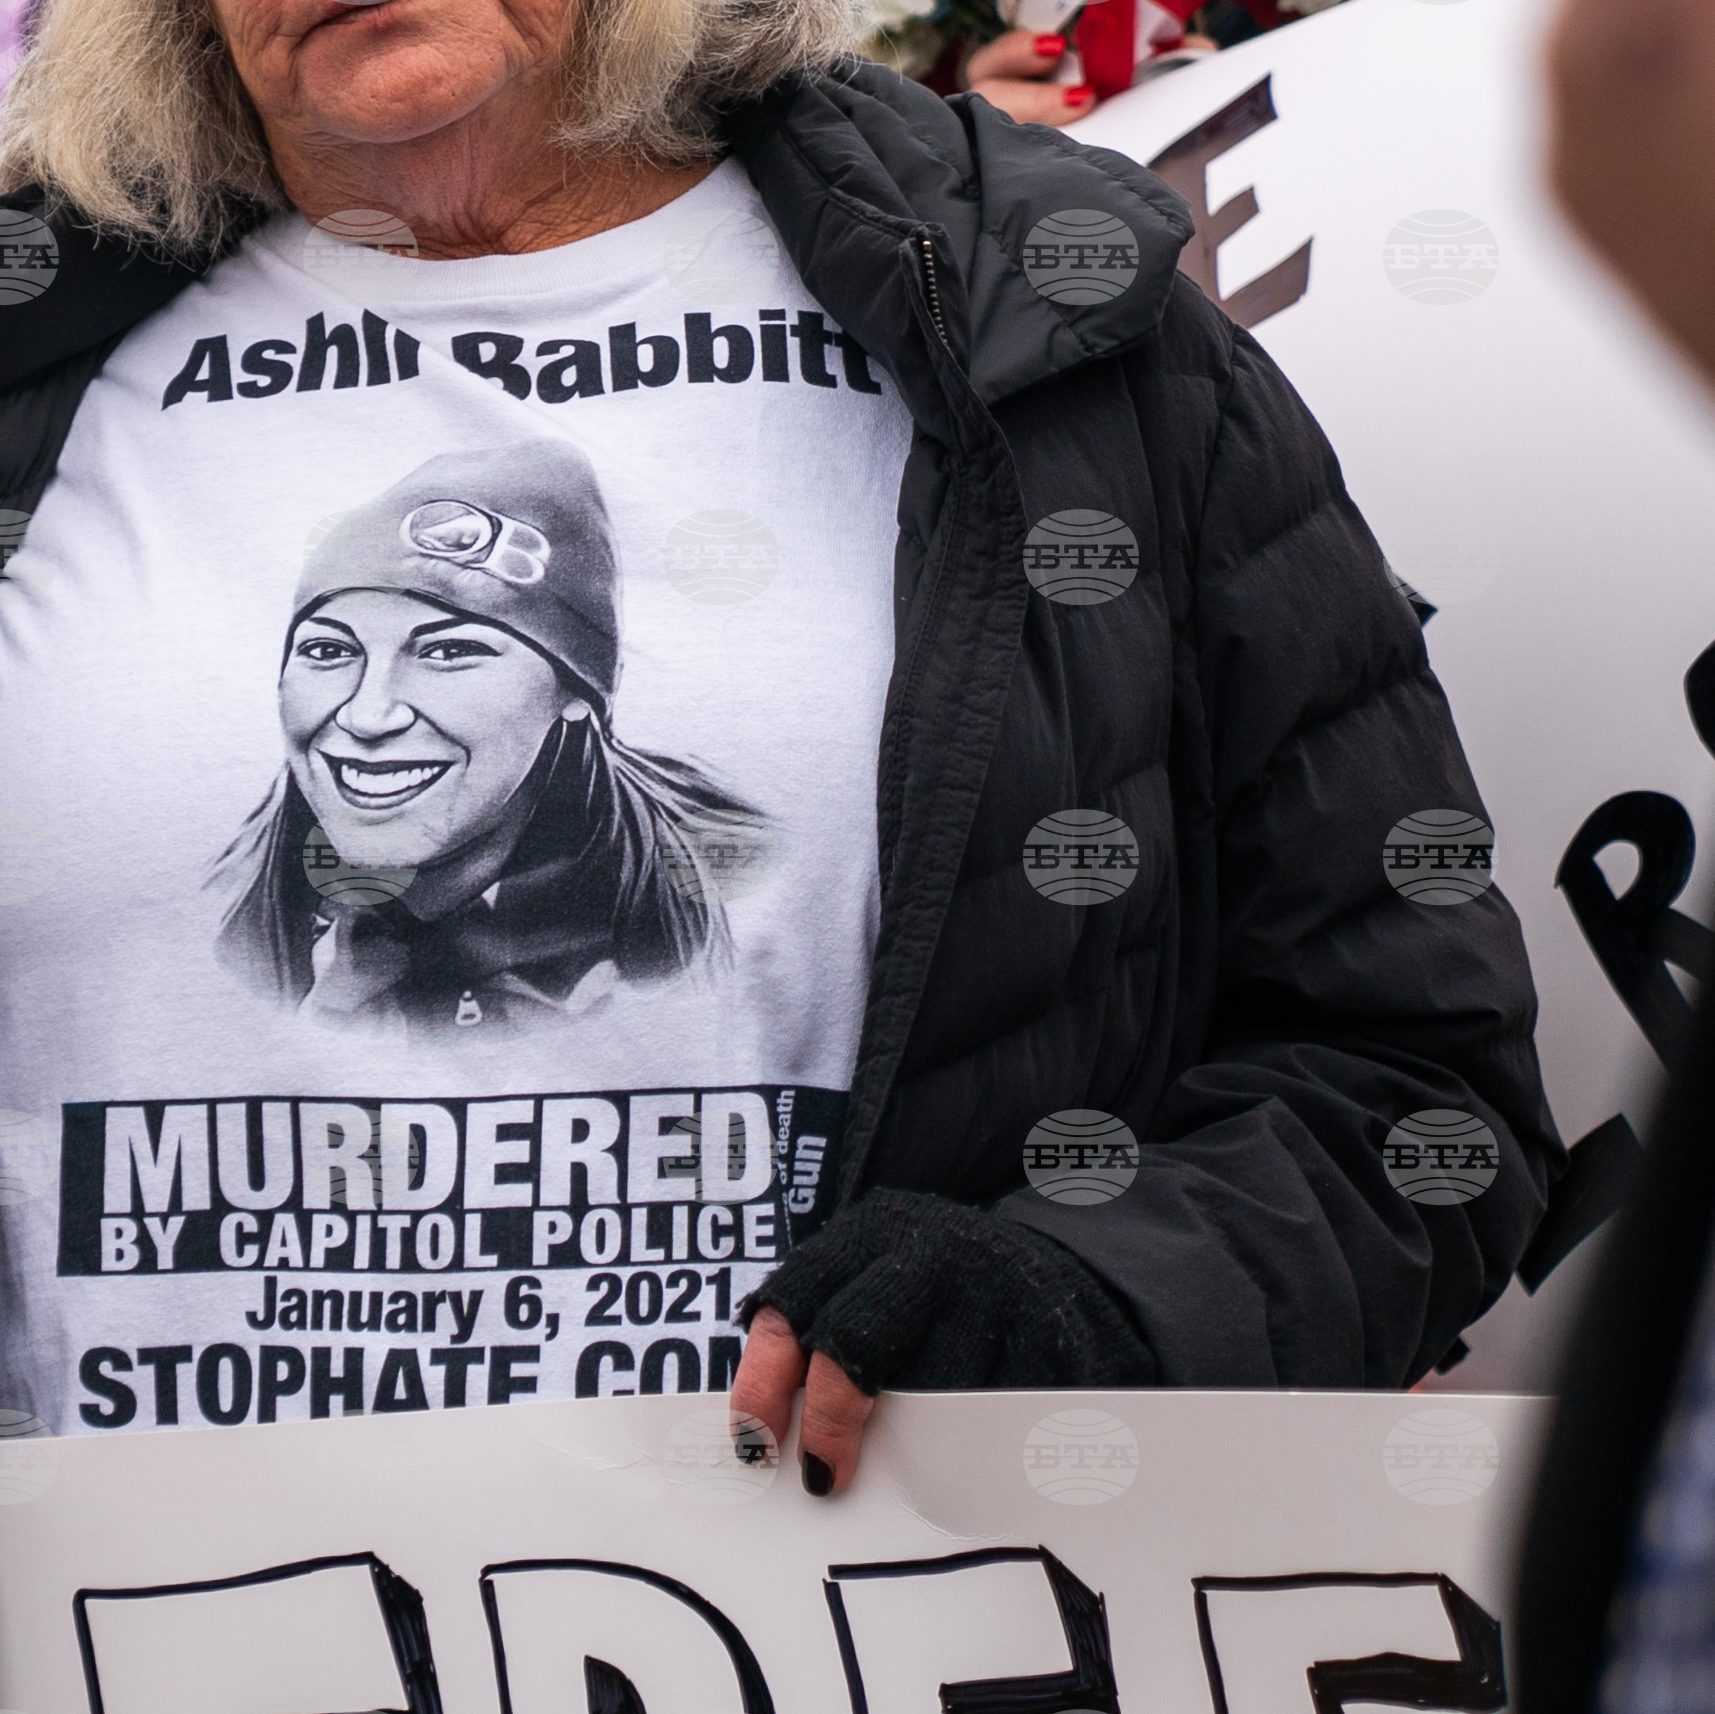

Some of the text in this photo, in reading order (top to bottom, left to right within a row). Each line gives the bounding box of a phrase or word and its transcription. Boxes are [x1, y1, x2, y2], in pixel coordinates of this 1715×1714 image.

[103, 1090, 778, 1215] MURDERED
[776, 1089, 796, 1154] death
[787, 1135, 827, 1214] Gun
[100, 1213, 183, 1273] BY
[220, 1208, 498, 1271] CAPITOL
[532, 1203, 777, 1265] POLICE
[245, 1267, 732, 1345] January 6, 2021
